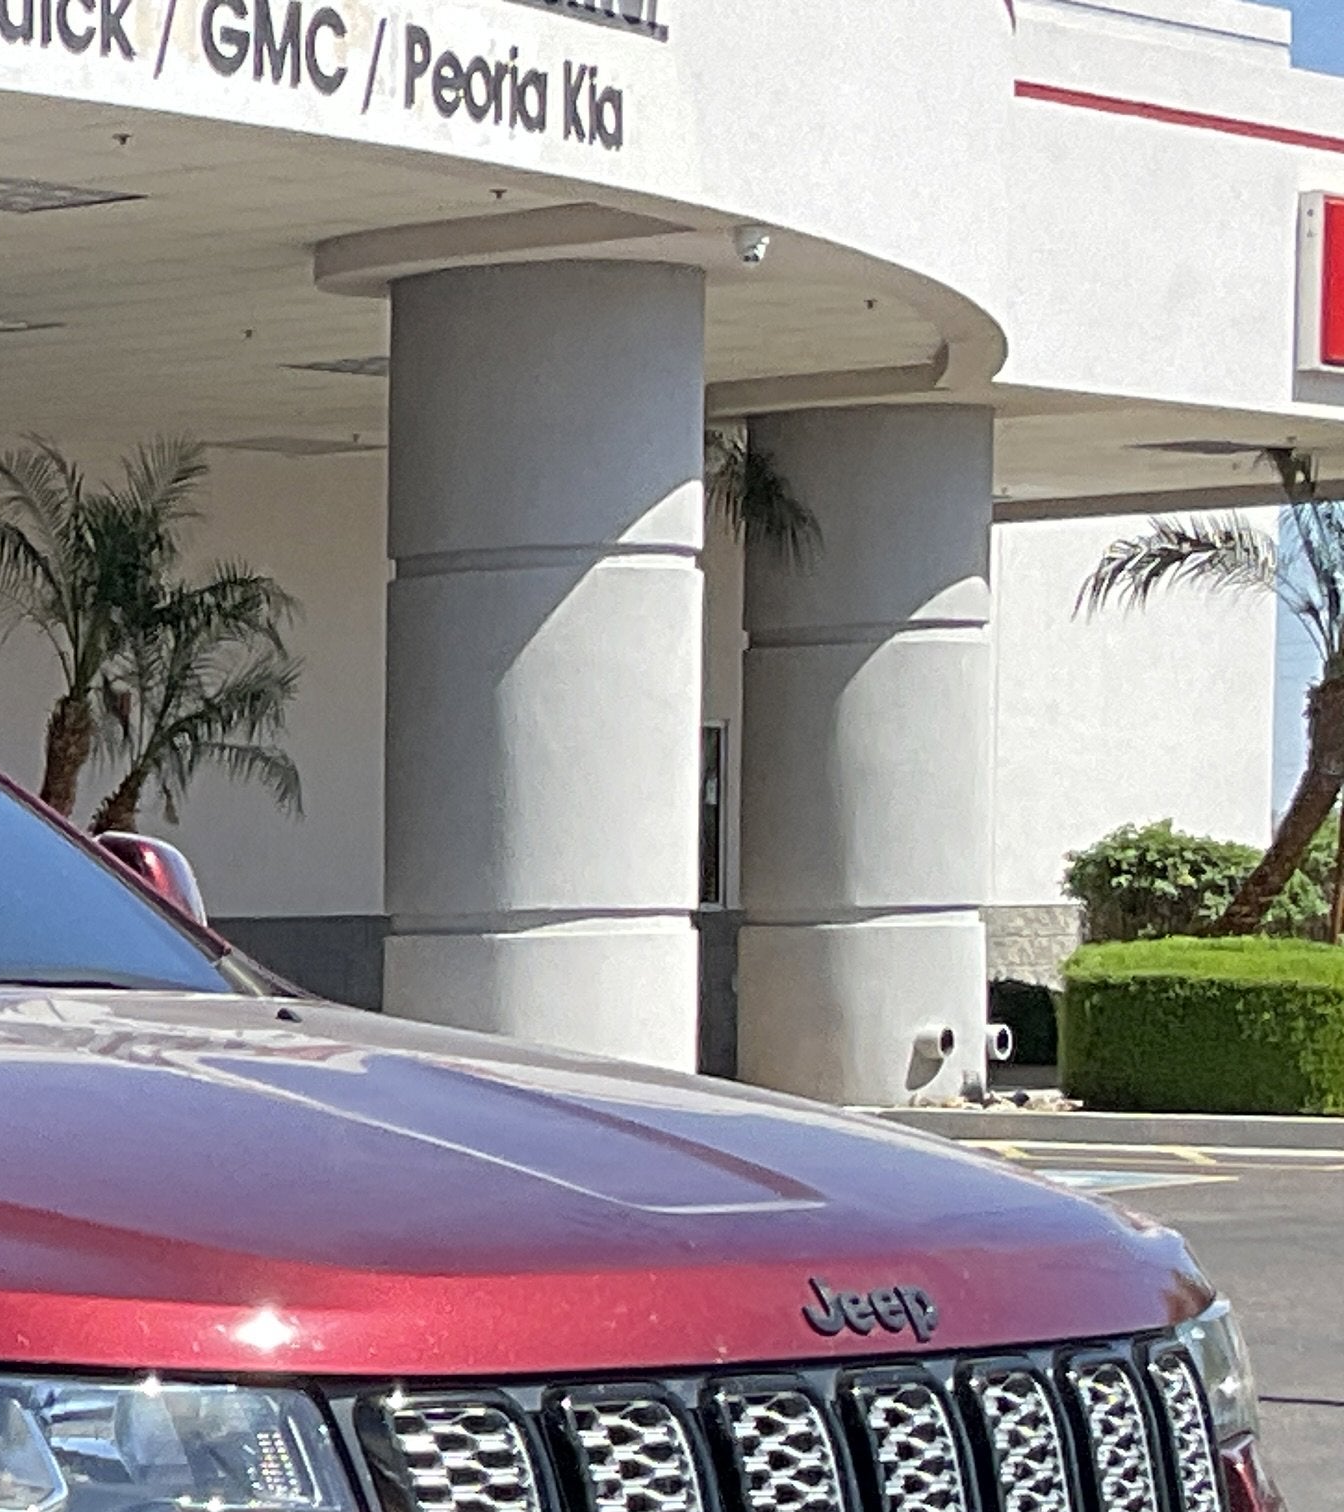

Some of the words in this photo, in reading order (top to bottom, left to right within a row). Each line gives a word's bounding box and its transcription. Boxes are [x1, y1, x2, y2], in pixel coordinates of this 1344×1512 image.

[200, 0, 347, 96] GMC
[361, 17, 387, 115] /
[404, 22, 549, 134] Peoria
[562, 58, 624, 152] Kia
[801, 1276, 939, 1343] Jeep
